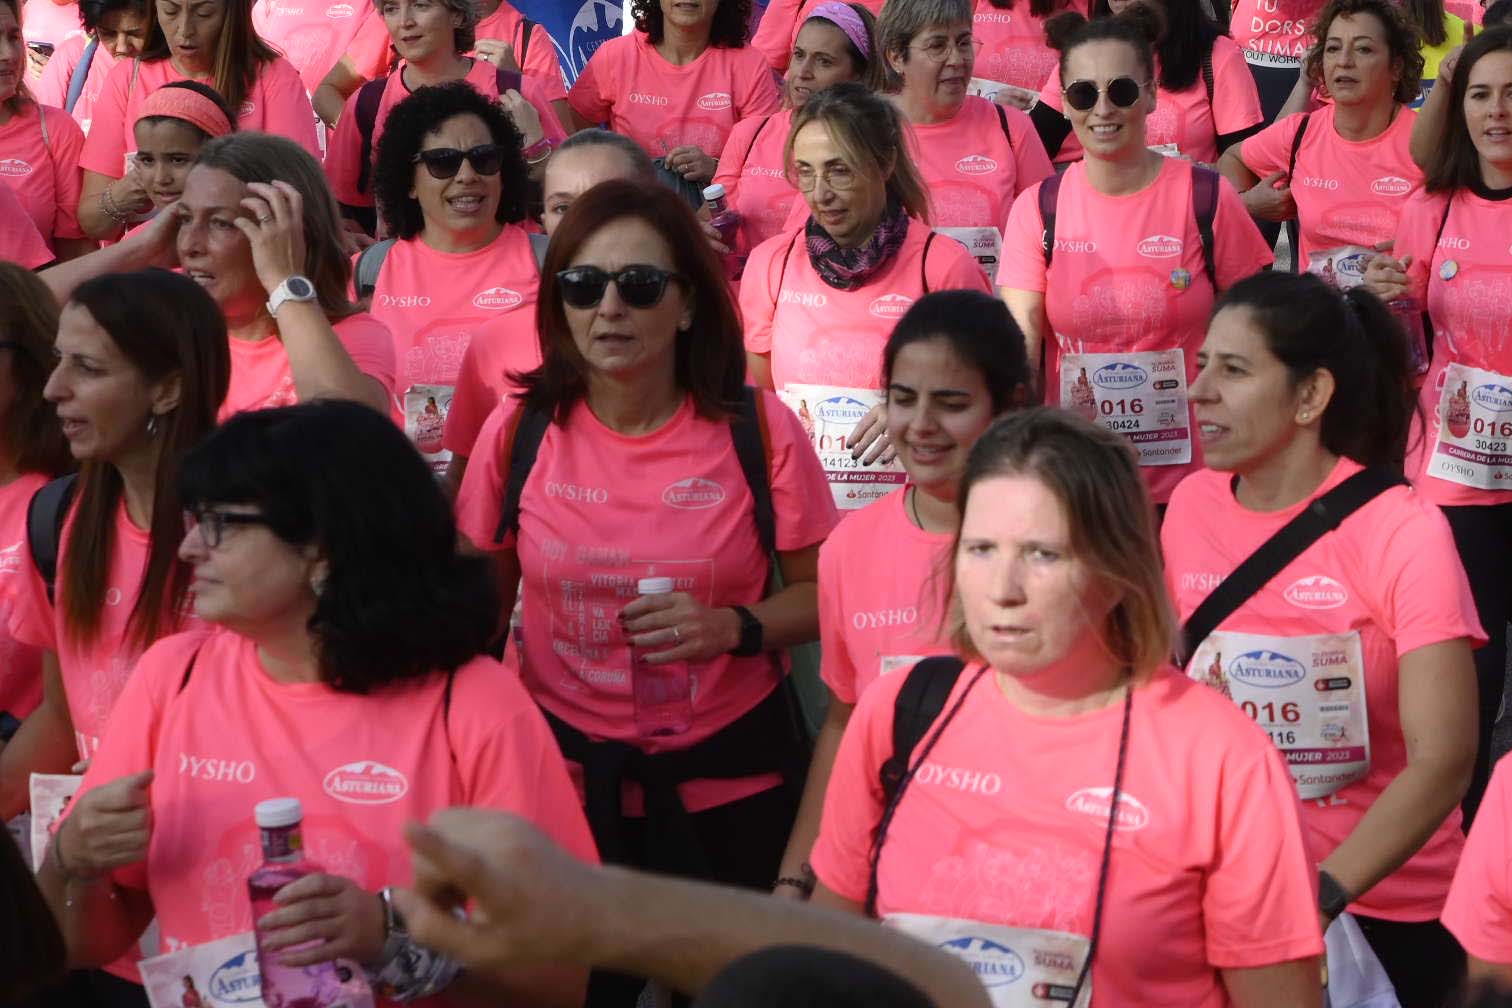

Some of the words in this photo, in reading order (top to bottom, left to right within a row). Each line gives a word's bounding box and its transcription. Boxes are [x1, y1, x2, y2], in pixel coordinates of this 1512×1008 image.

[973, 13, 1011, 24] OYSHO
[629, 93, 669, 106] OYSHO
[956, 160, 997, 172] ASTURIANA
[1373, 182, 1409, 192] ASTURIANA
[1141, 244, 1181, 253] ASTURIANA
[476, 295, 520, 306] ASTURIANA
[1097, 373, 1143, 384] ASTURIANA
[1100, 398, 1144, 415] 016
[1106, 419, 1140, 430] 30424
[1475, 440, 1507, 452] 30423
[1142, 448, 1182, 457] Santander
[1441, 463, 1475, 478] OYSHO
[849, 474, 876, 482] MUJER
[545, 481, 608, 504] OYSHO
[667, 489, 724, 503] ASTURIANA
[1181, 573, 1225, 591] OYSH
[1292, 589, 1346, 605] ASTURIANA
[853, 607, 917, 629] OYSHO
[1312, 658, 1348, 668] SUMA
[1235, 663, 1301, 679] ASTURIANA
[1285, 751, 1322, 762] MUJER
[332, 773, 405, 795] ASTURIANA
[914, 764, 1001, 795] OYSHO
